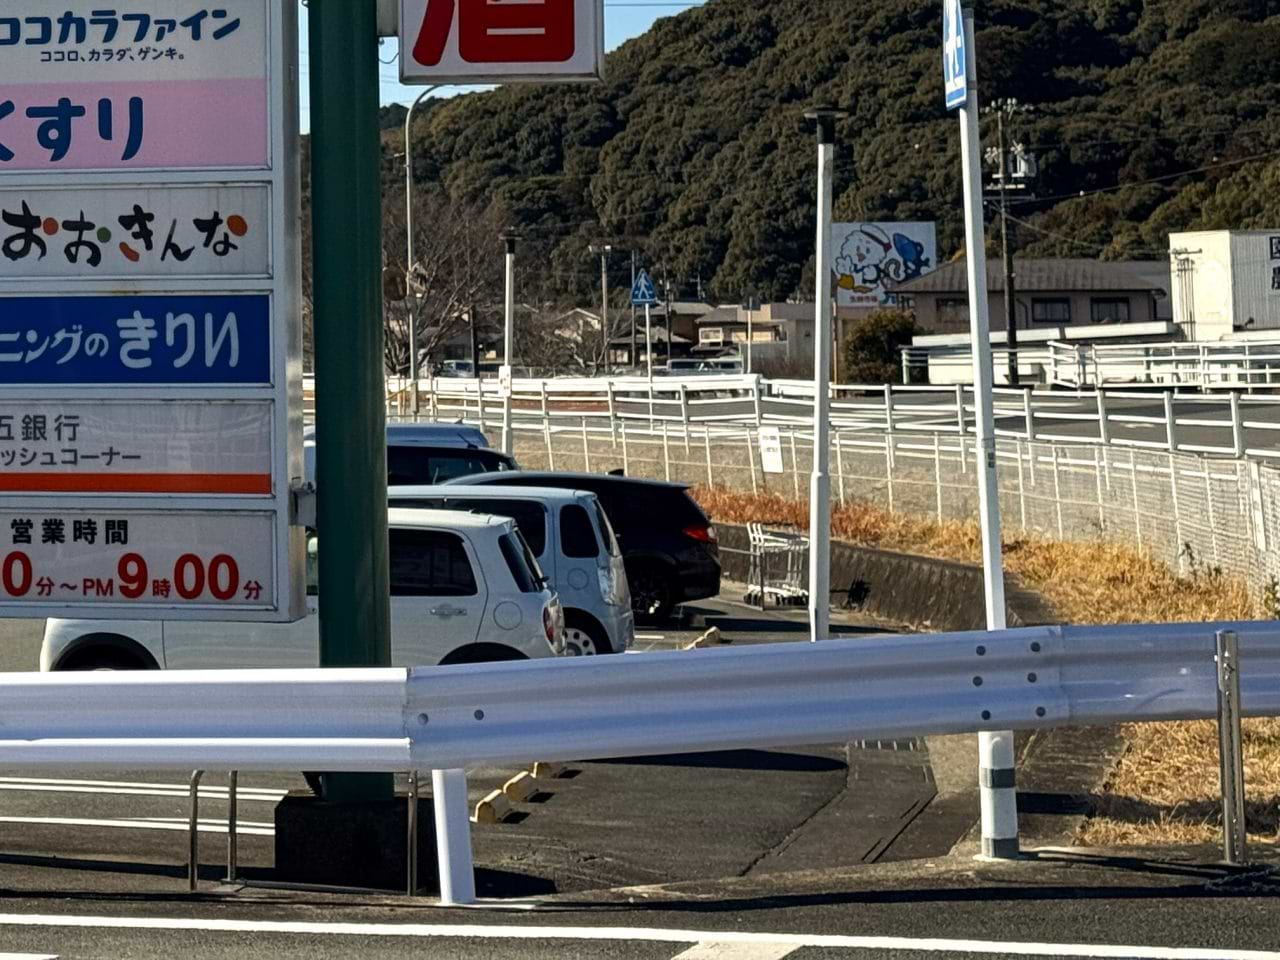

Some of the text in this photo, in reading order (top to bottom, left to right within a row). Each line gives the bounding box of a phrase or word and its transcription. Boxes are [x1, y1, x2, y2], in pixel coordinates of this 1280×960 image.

[40, 46, 185, 63] ココロ、カラダ、ゲンキ。
[11, 518, 129, 545] 営業時間
